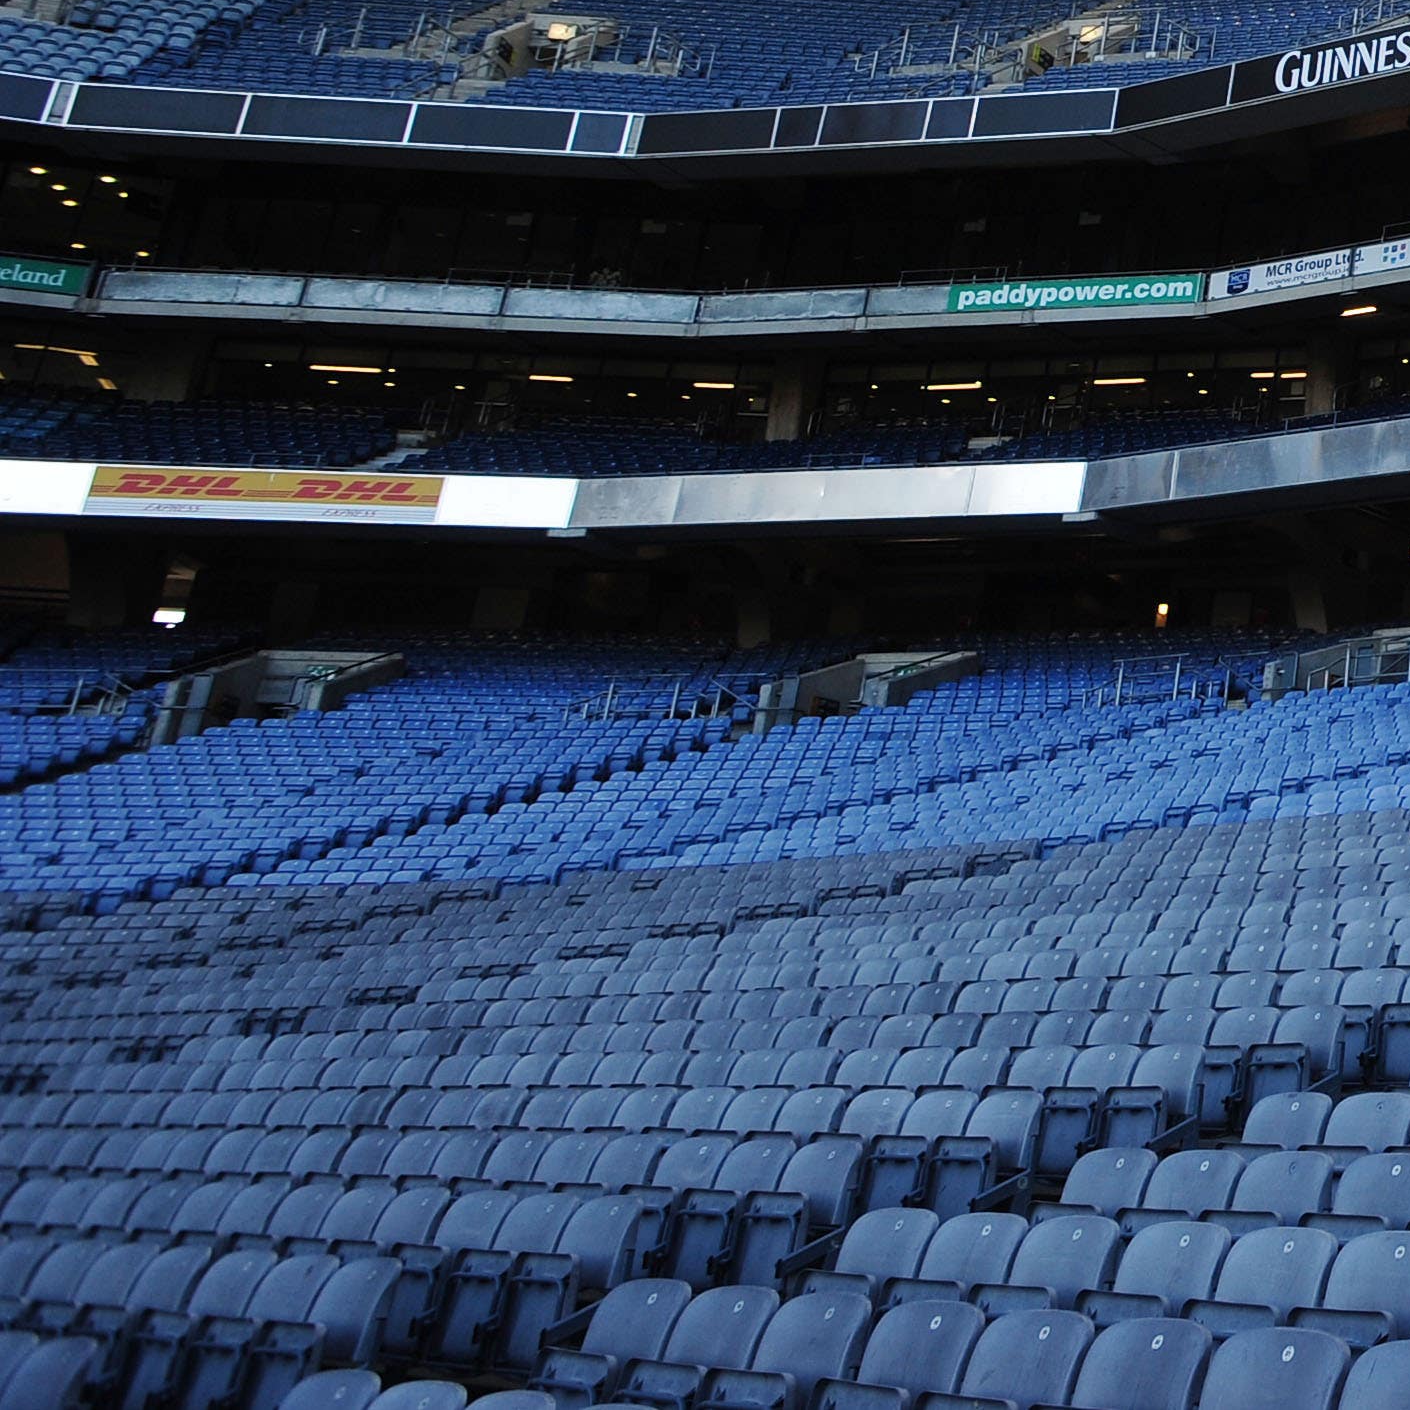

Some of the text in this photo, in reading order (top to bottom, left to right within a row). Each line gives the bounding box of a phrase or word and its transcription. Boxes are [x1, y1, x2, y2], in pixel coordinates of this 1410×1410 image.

[0, 263, 66, 286] eland
[1265, 262, 1293, 278] MCR
[1295, 257, 1332, 273] Group
[957, 280, 1193, 310] paddypower.com
[113, 473, 418, 503] DHL DHL
